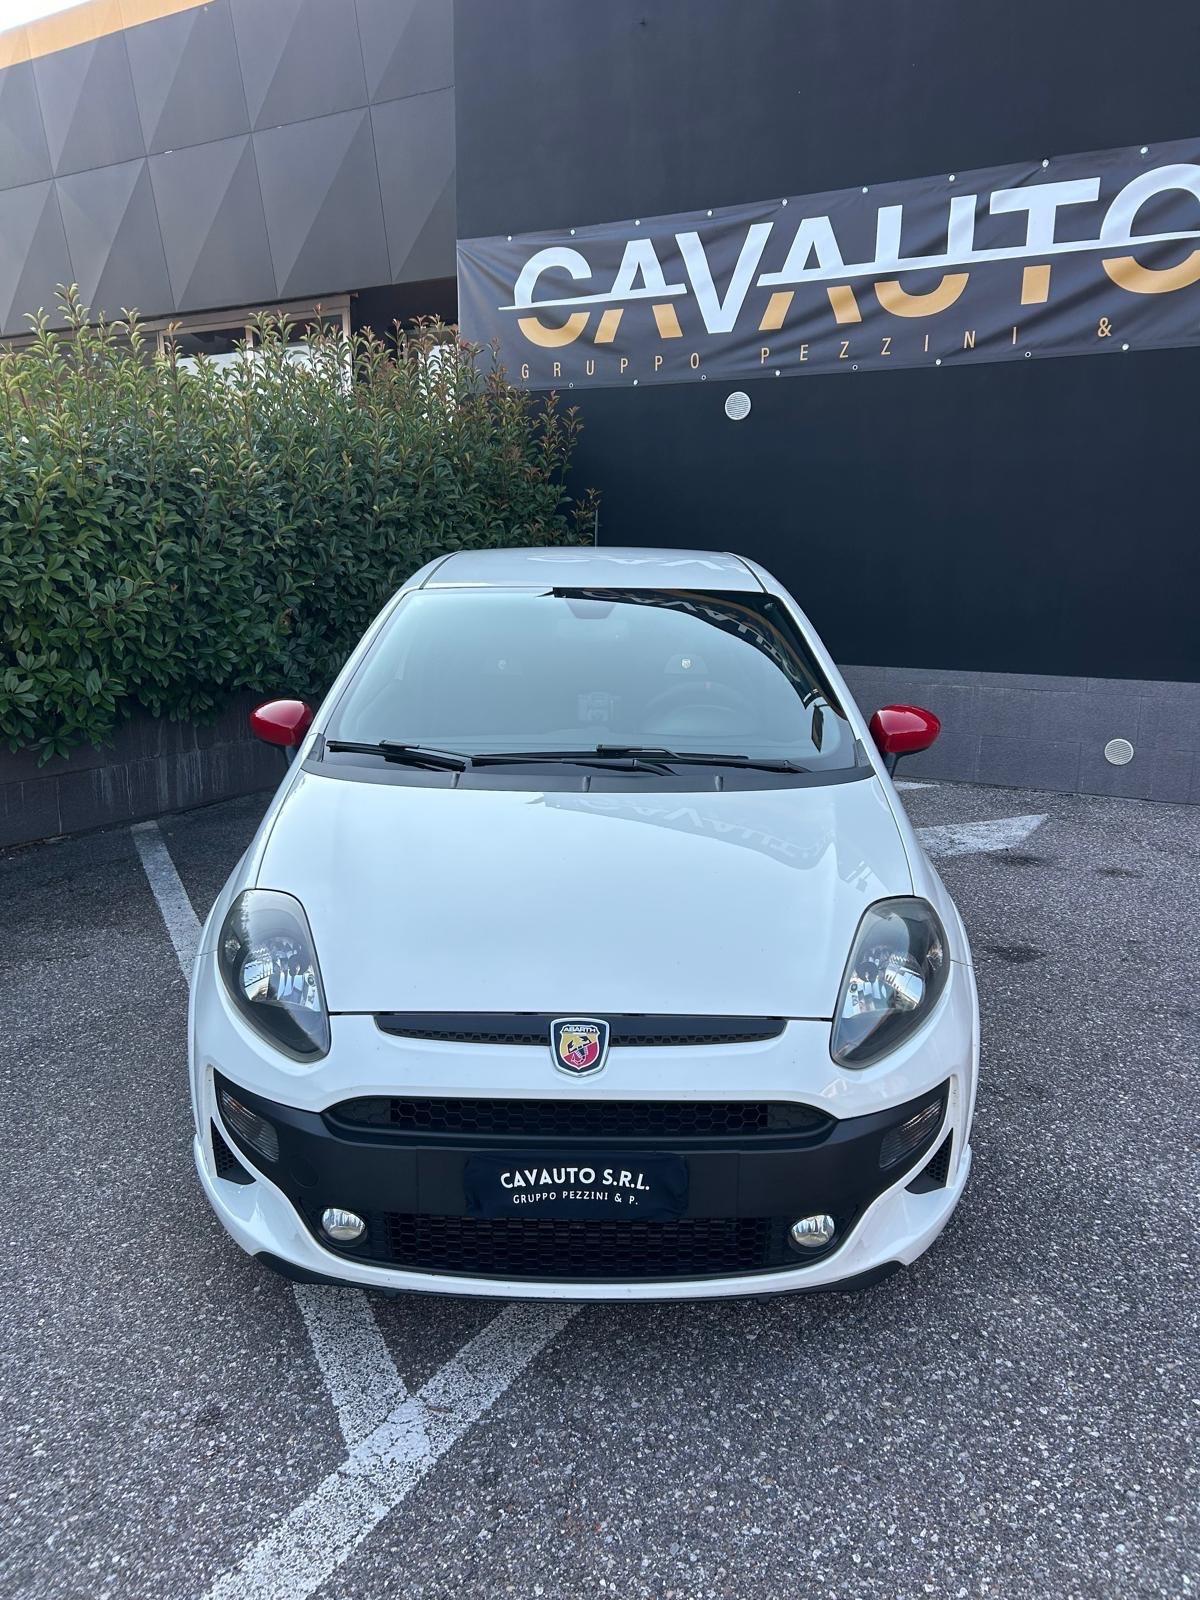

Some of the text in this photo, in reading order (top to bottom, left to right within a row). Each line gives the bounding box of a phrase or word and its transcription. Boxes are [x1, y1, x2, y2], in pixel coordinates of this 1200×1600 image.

[498, 163, 1200, 348] CAVAUTO
[521, 317, 1112, 379] GRUPPO PEZZINI &
[500, 1167, 650, 1191] CAVAUTO S.R.L.
[513, 1190, 639, 1205] GRUPPO PEZZINI & P.
